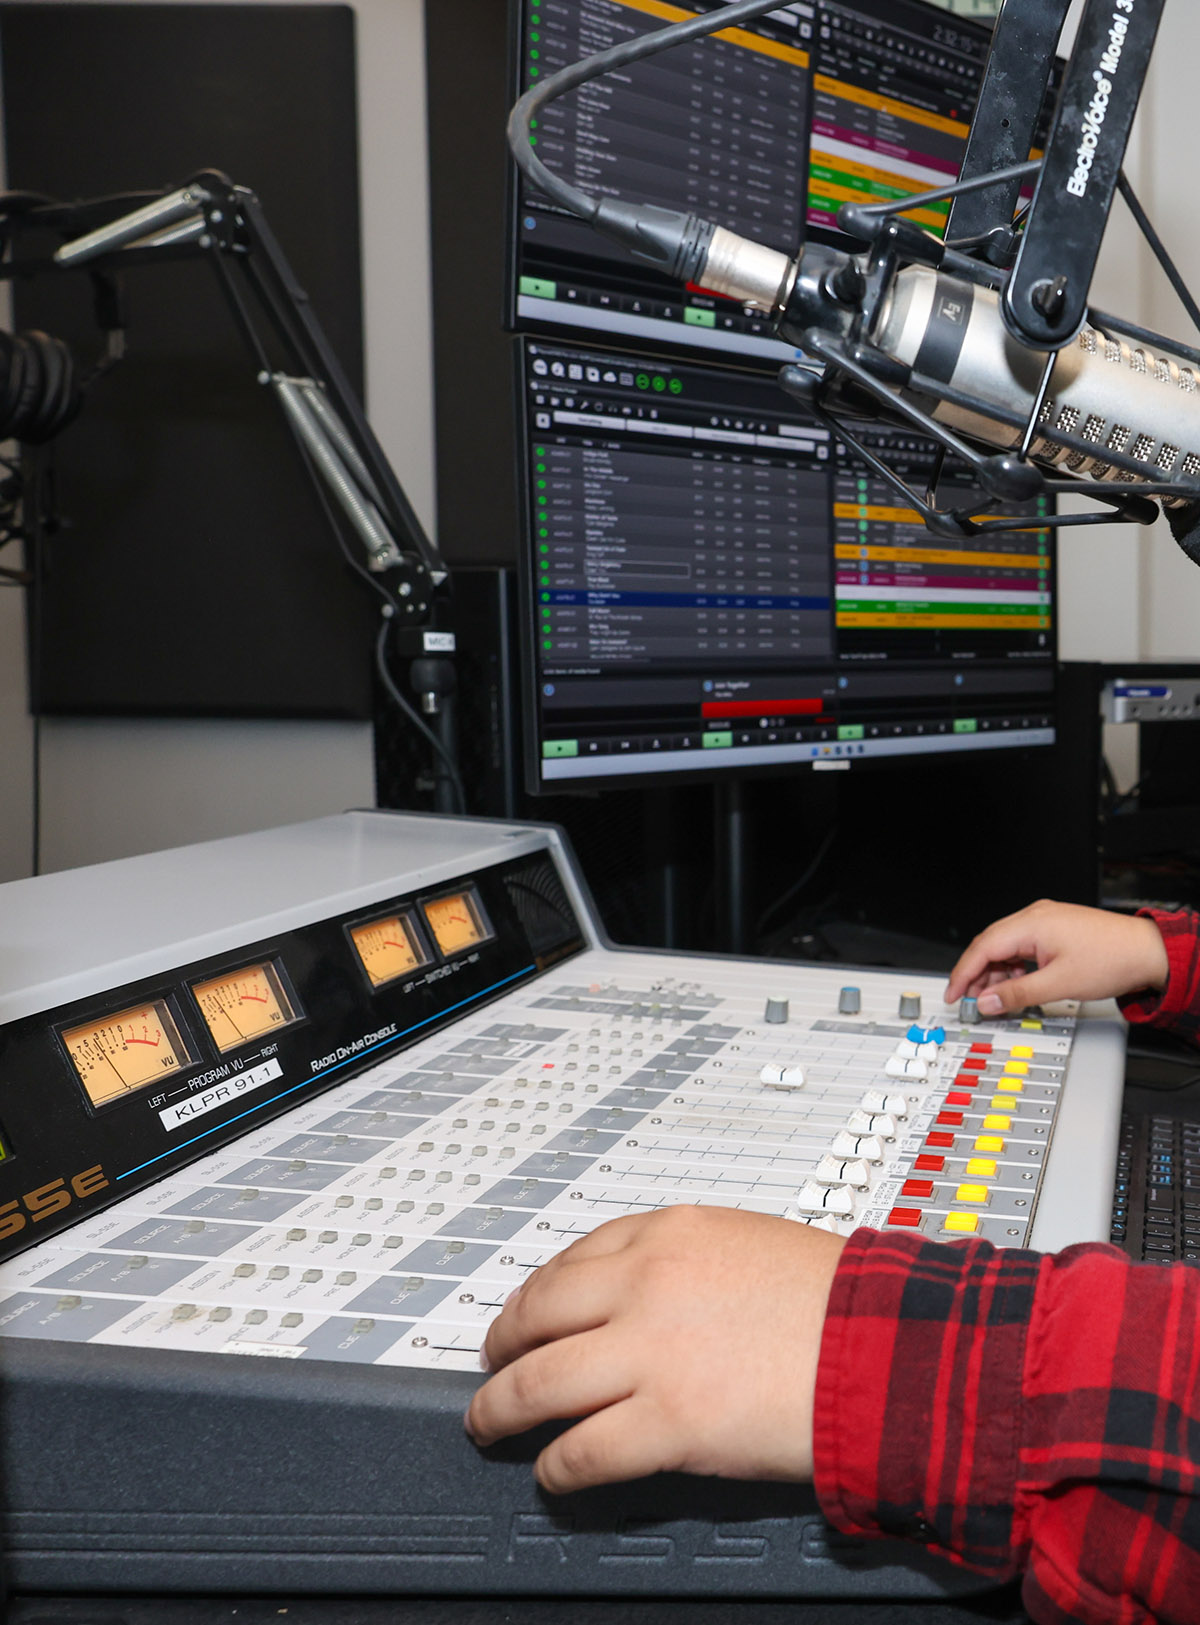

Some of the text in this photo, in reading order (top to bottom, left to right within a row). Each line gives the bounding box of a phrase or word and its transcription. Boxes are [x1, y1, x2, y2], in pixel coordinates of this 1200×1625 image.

[1099, 13, 1130, 74] Model
[161, 1055, 175, 1068] VU
[147, 1042, 279, 1109] LEFT PROGRAM VU RIGHT
[175, 1067, 271, 1120] KLPR 91.1
[476, 1219, 493, 1232] CUE
[435, 1254, 455, 1266] CUE
[390, 1292, 411, 1305] CUE
[337, 1334, 360, 1350] CUE
